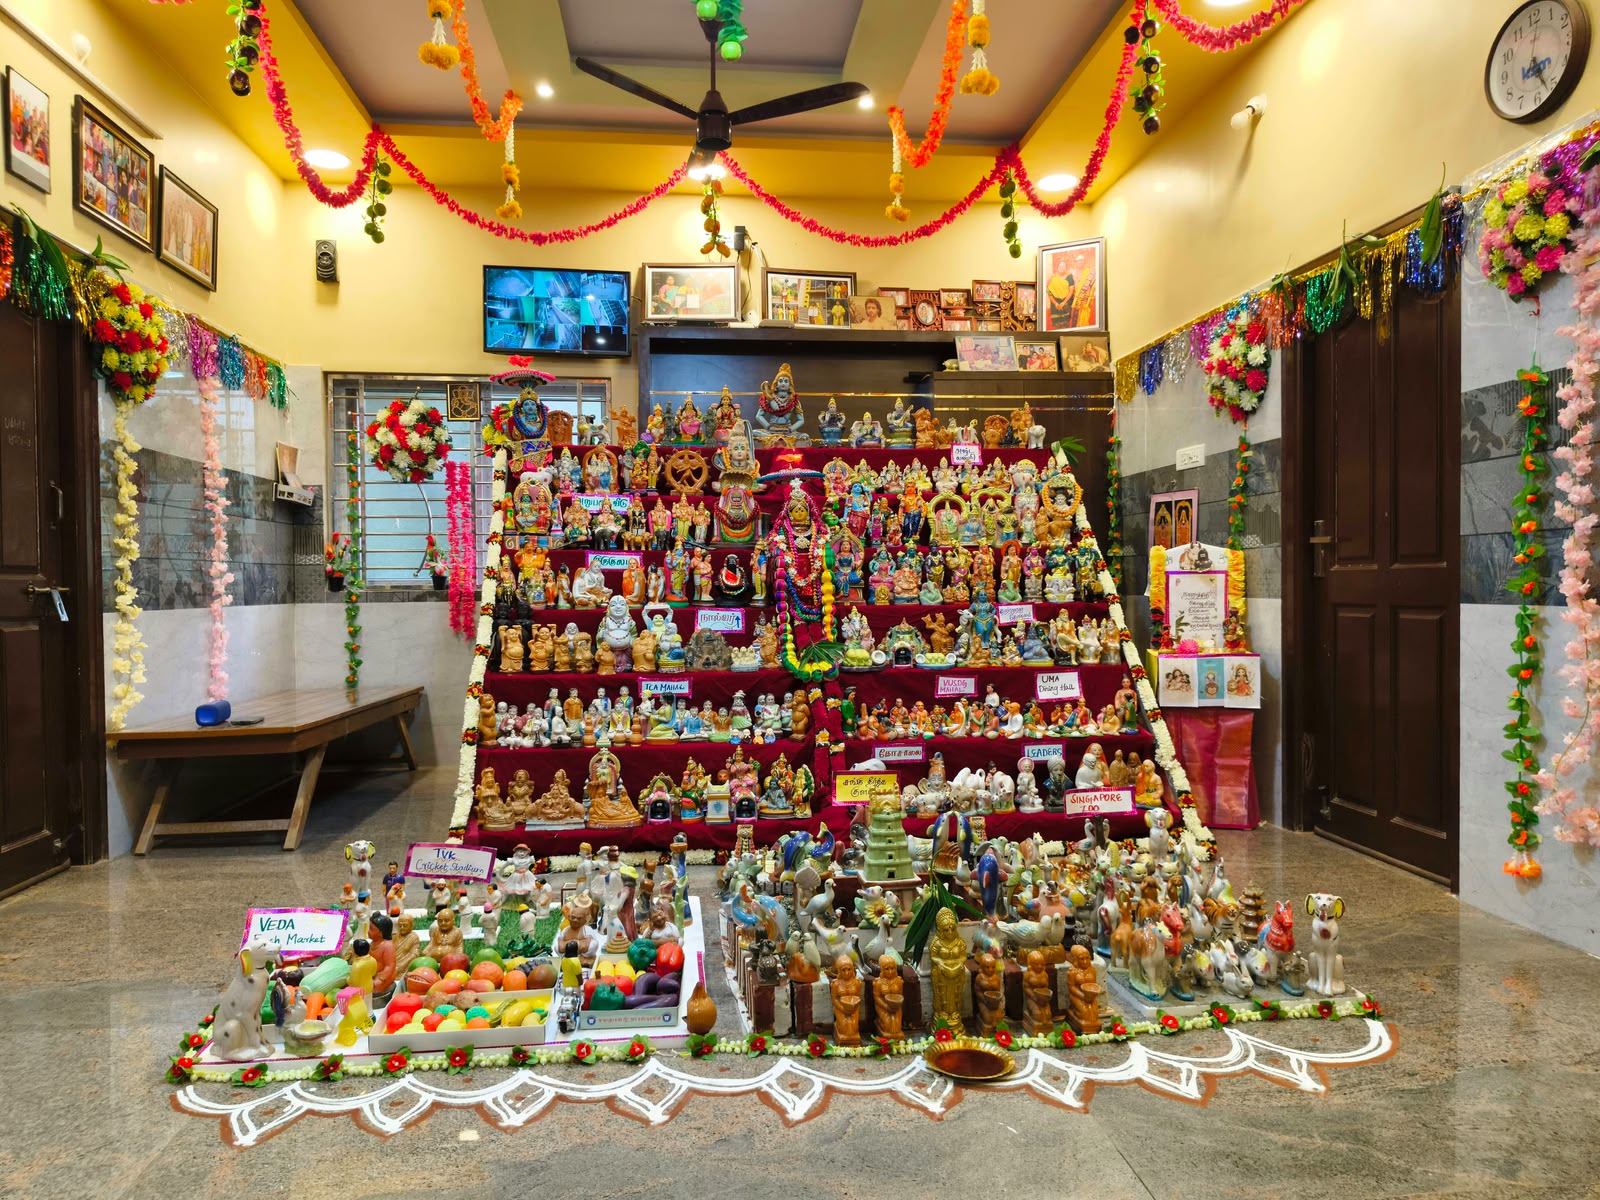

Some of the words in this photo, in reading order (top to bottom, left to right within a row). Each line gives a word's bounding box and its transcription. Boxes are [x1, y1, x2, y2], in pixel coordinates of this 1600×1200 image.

[1527, 8, 1541, 28] 12
[1548, 7, 1553, 21] 1
[1560, 12, 1569, 30] 2
[1513, 26, 1523, 43] 11
[1502, 47, 1514, 66] 10
[1501, 71, 1508, 85] 9
[1506, 87, 1514, 102] 8
[1534, 92, 1542, 106] 6
[1517, 95, 1525, 110] 7
[700, 612, 736, 626] நால்வர்
[1041, 675, 1060, 683] UMA
[1038, 685, 1058, 695] Dining
[1059, 683, 1075, 691] Hall
[1026, 746, 1063, 758] LEADERS
[1070, 793, 1123, 806] SINGAPORE
[1081, 804, 1100, 813] ZOO
[415, 859, 449, 871] Cricket
[449, 862, 485, 874] Stadium
[259, 917, 296, 932] VEDA
[286, 933, 326, 945] Market
